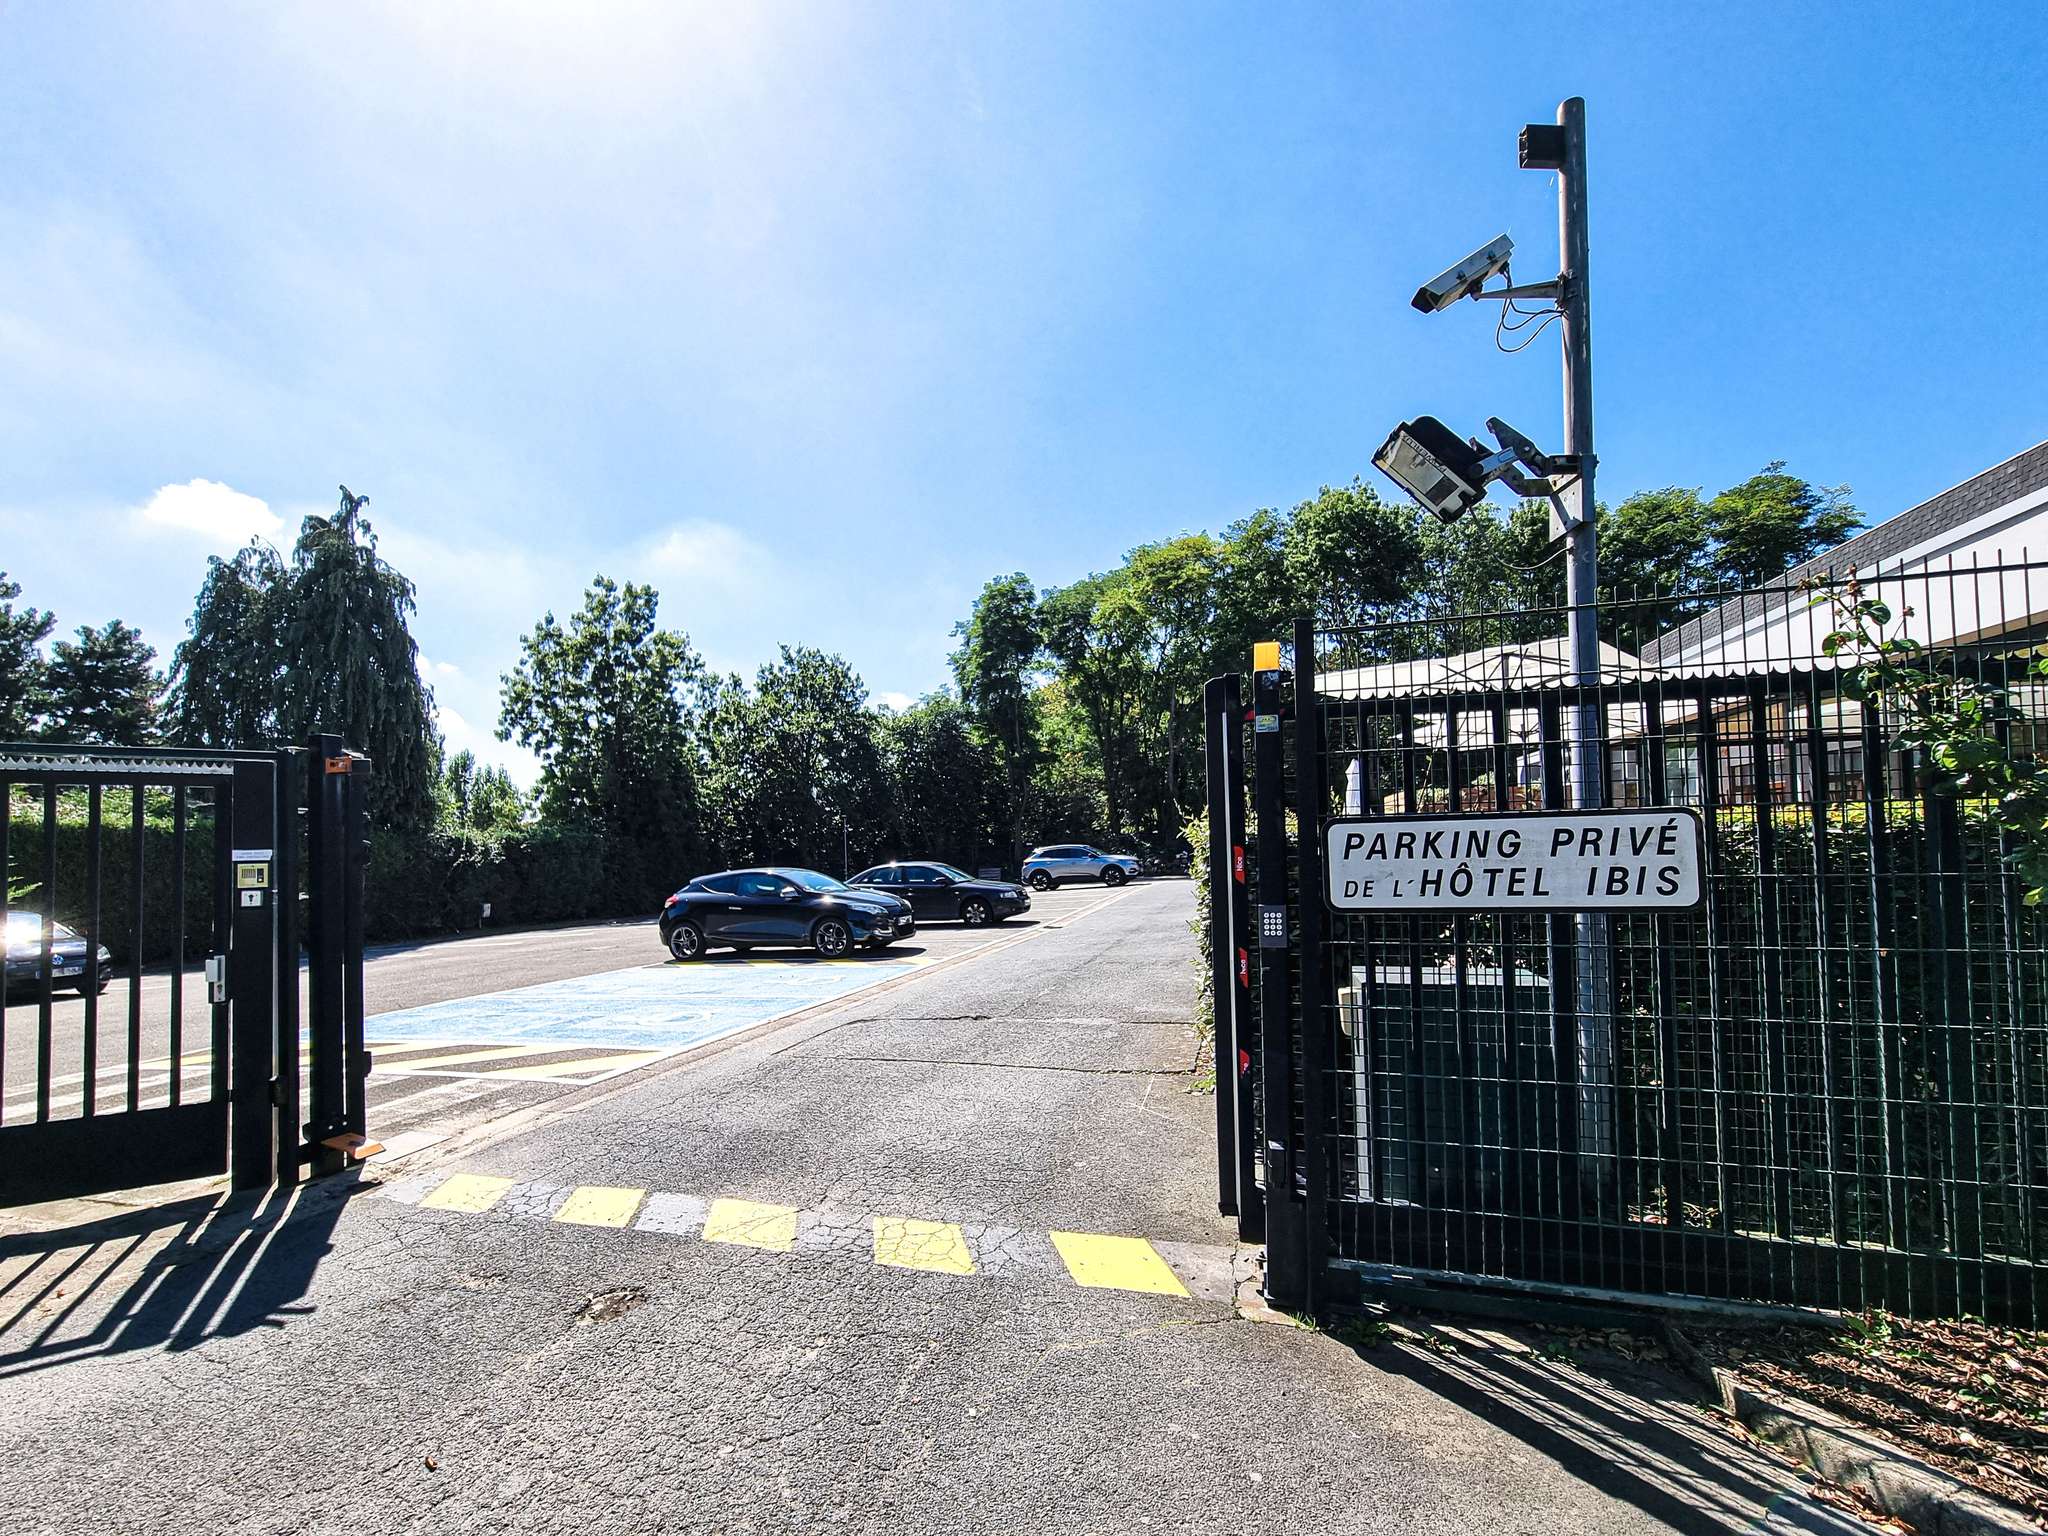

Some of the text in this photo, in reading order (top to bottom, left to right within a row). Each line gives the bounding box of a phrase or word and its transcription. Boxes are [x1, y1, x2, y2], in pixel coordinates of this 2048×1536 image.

[1343, 817, 1679, 860] PARKING PRIVÉ
[1343, 880, 1375, 898] DE
[1586, 865, 1681, 896] IBIS
